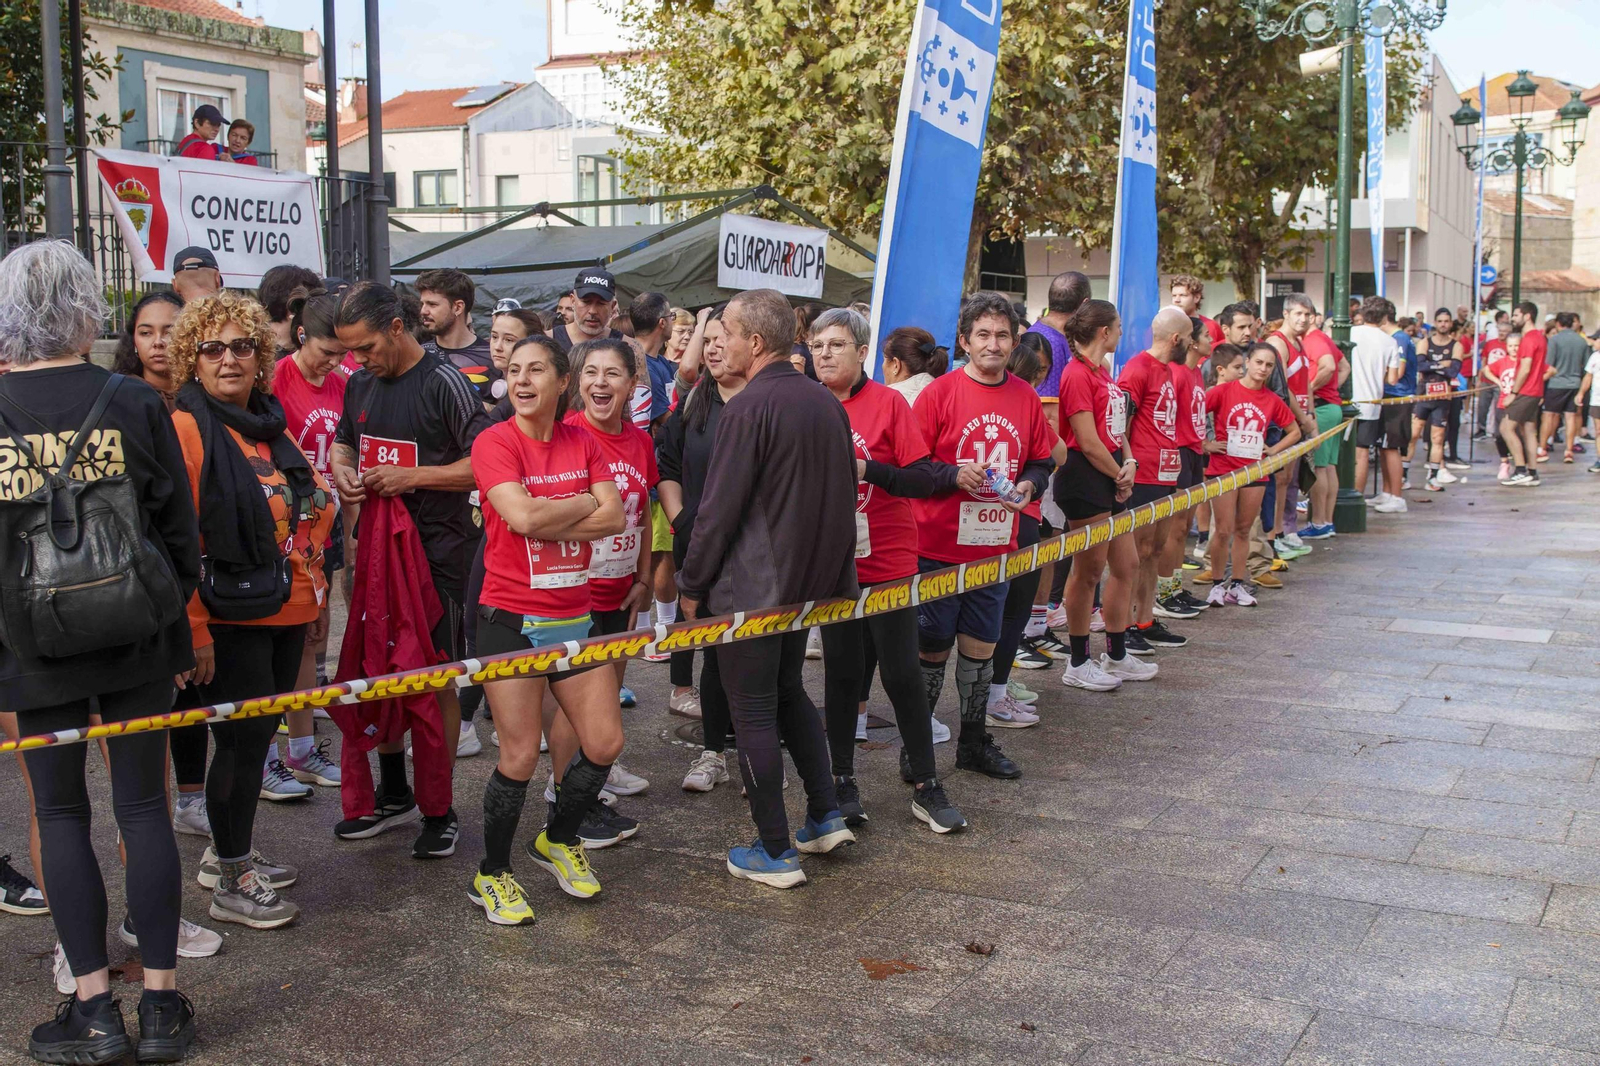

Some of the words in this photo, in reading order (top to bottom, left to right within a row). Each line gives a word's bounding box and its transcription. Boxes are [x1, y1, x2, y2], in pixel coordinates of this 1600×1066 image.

[191, 194, 302, 226] CONCELLO
[207, 228, 235, 253] DE
[243, 230, 291, 255] VIGO
[724, 232, 825, 280] GUARDARROPA
[584, 276, 609, 288] HOKA
[962, 417, 981, 436] #EU
[981, 412, 1019, 438] MÓVOME
[1240, 434, 1259, 445] 571
[377, 446, 400, 465] 84
[973, 441, 1010, 478] 14
[608, 460, 648, 487] MÓVOME
[978, 508, 1007, 523] 600
[1113, 514, 1132, 537] GADIS
[1135, 507, 1152, 529] GADIS
[612, 534, 636, 552] 533
[1065, 532, 1087, 556] GADIS
[1090, 523, 1110, 546] GADIS
[557, 540, 581, 557] 19
[1036, 541, 1061, 567] GADIS
[965, 561, 999, 589] GADIS
[1006, 551, 1033, 578] GADIS
[865, 583, 910, 615] GADIS
[919, 571, 957, 602] GADIS
[803, 598, 855, 627] GADIS
[485, 884, 502, 913] ATOM
